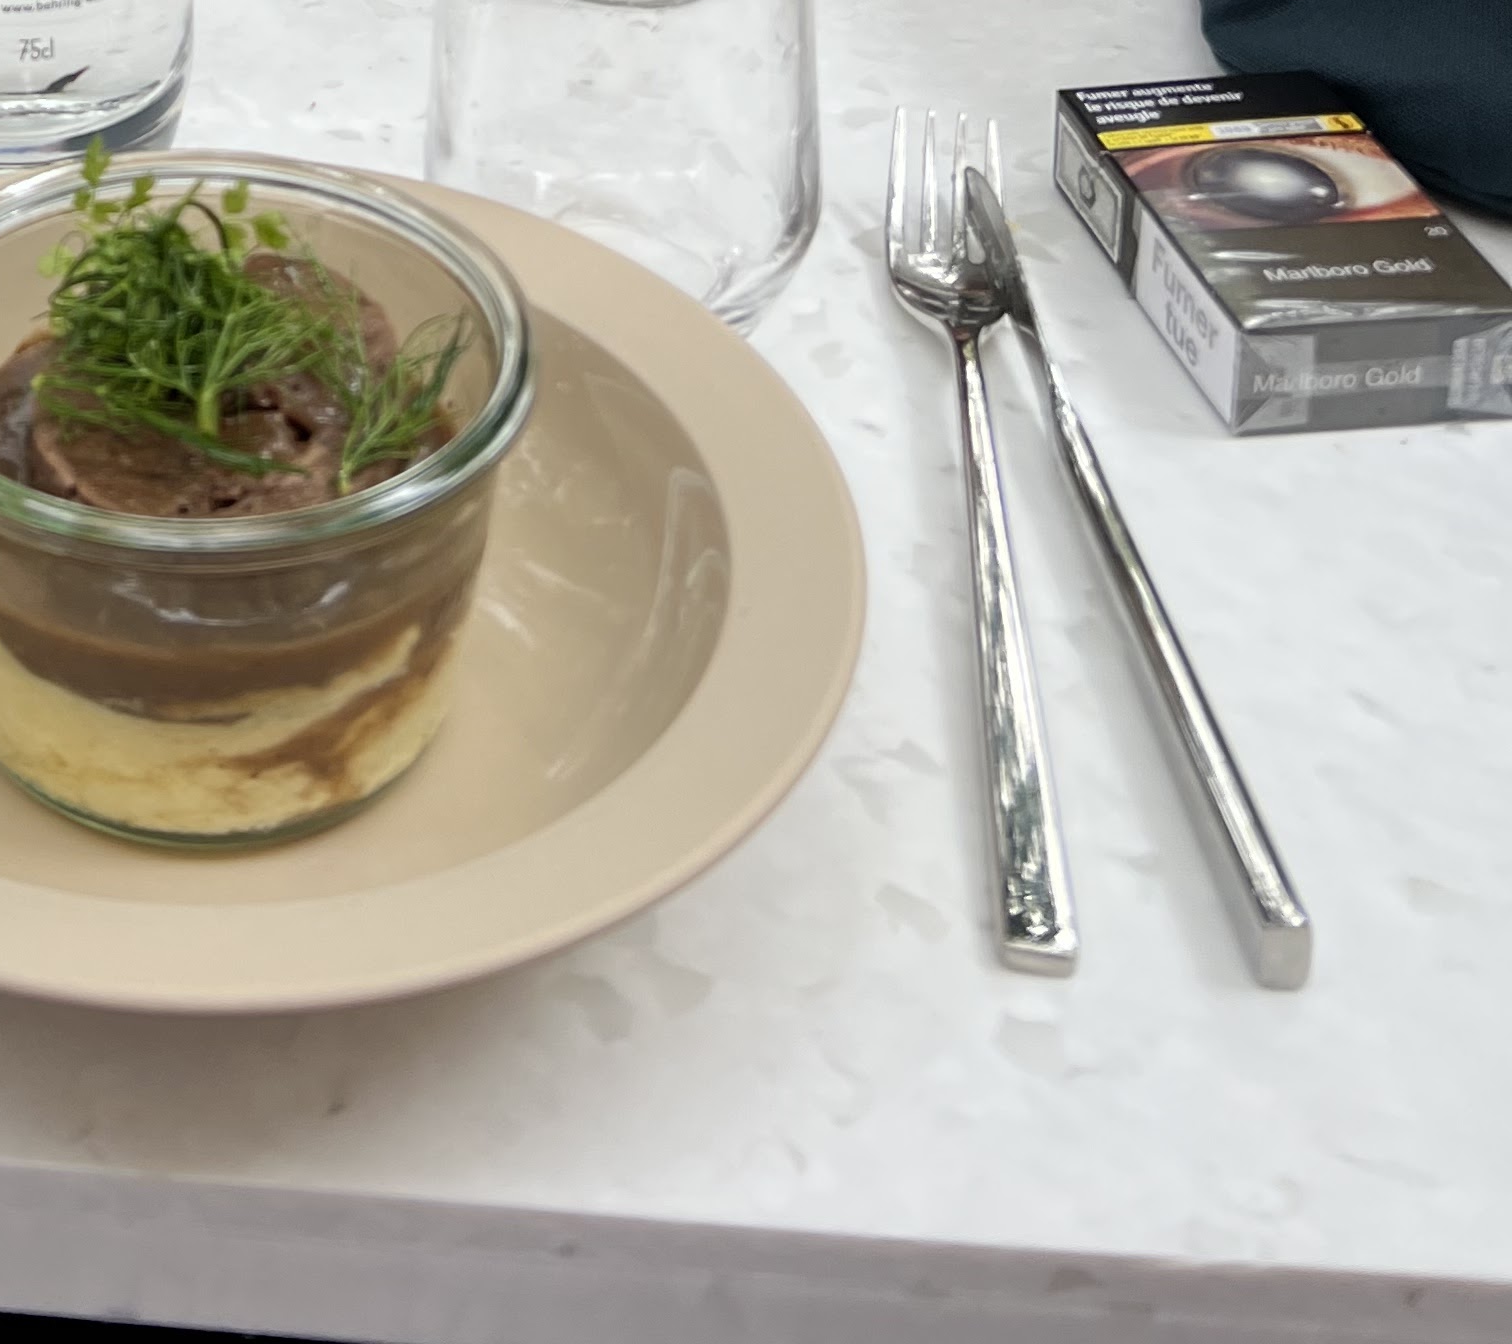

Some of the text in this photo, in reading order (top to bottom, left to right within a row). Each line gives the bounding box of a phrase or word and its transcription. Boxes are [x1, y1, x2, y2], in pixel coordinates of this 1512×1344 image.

[18, 36, 55, 62] 75cl
[1076, 82, 1214, 103] Fumer augmente
[1084, 90, 1244, 113] le risque de devenir
[1096, 110, 1162, 126] aveugle
[1424, 225, 1450, 237] 20
[1263, 257, 1434, 282] Marlboro Gold
[1152, 237, 1219, 350] Fumer
[1165, 301, 1198, 367] tue
[1253, 364, 1423, 393] Marlboro Gold
